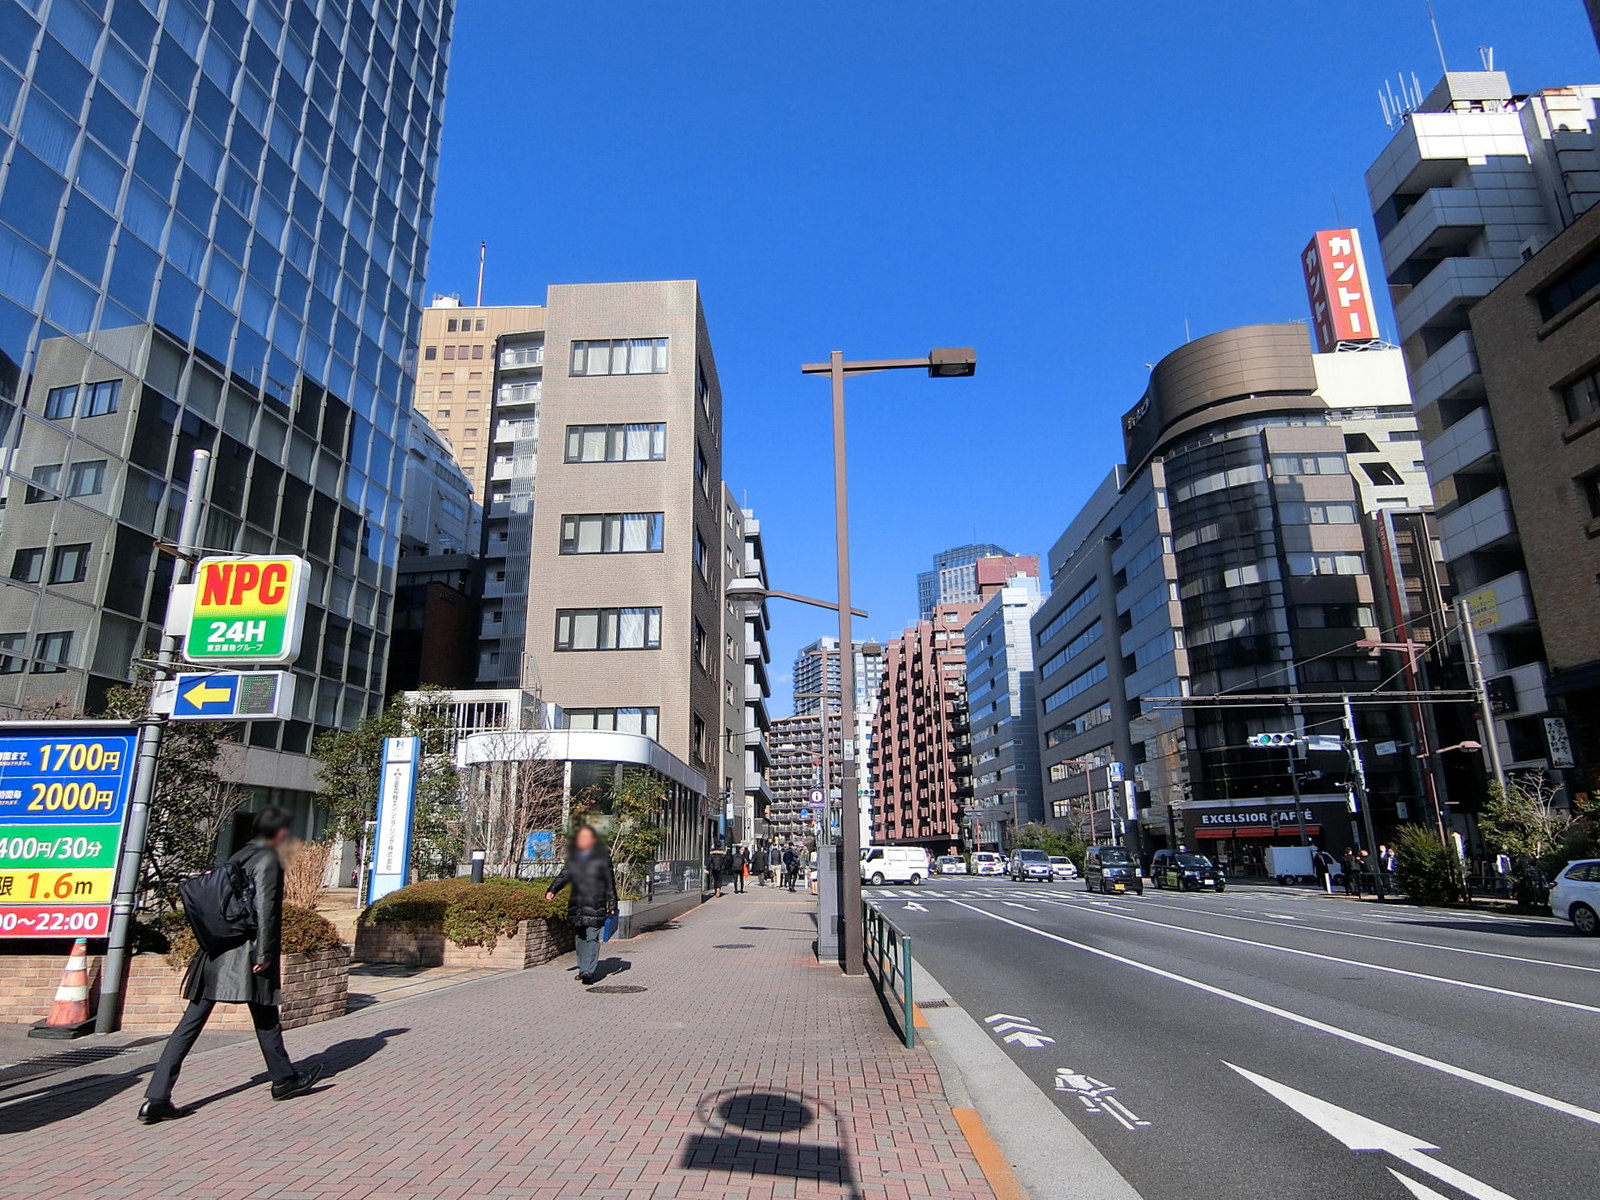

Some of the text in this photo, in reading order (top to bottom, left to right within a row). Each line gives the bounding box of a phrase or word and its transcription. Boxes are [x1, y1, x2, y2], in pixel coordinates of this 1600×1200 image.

[1306, 248, 1329, 345] カントー
[1328, 236, 1361, 333] カントー
[201, 563, 288, 606] NPC
[207, 620, 267, 643] 24H
[40, 743, 121, 772] 1700円
[27, 782, 114, 811] 2000円
[1202, 812, 1267, 824] EXCELSIOR
[0, 911, 99, 931] 0～22:00
